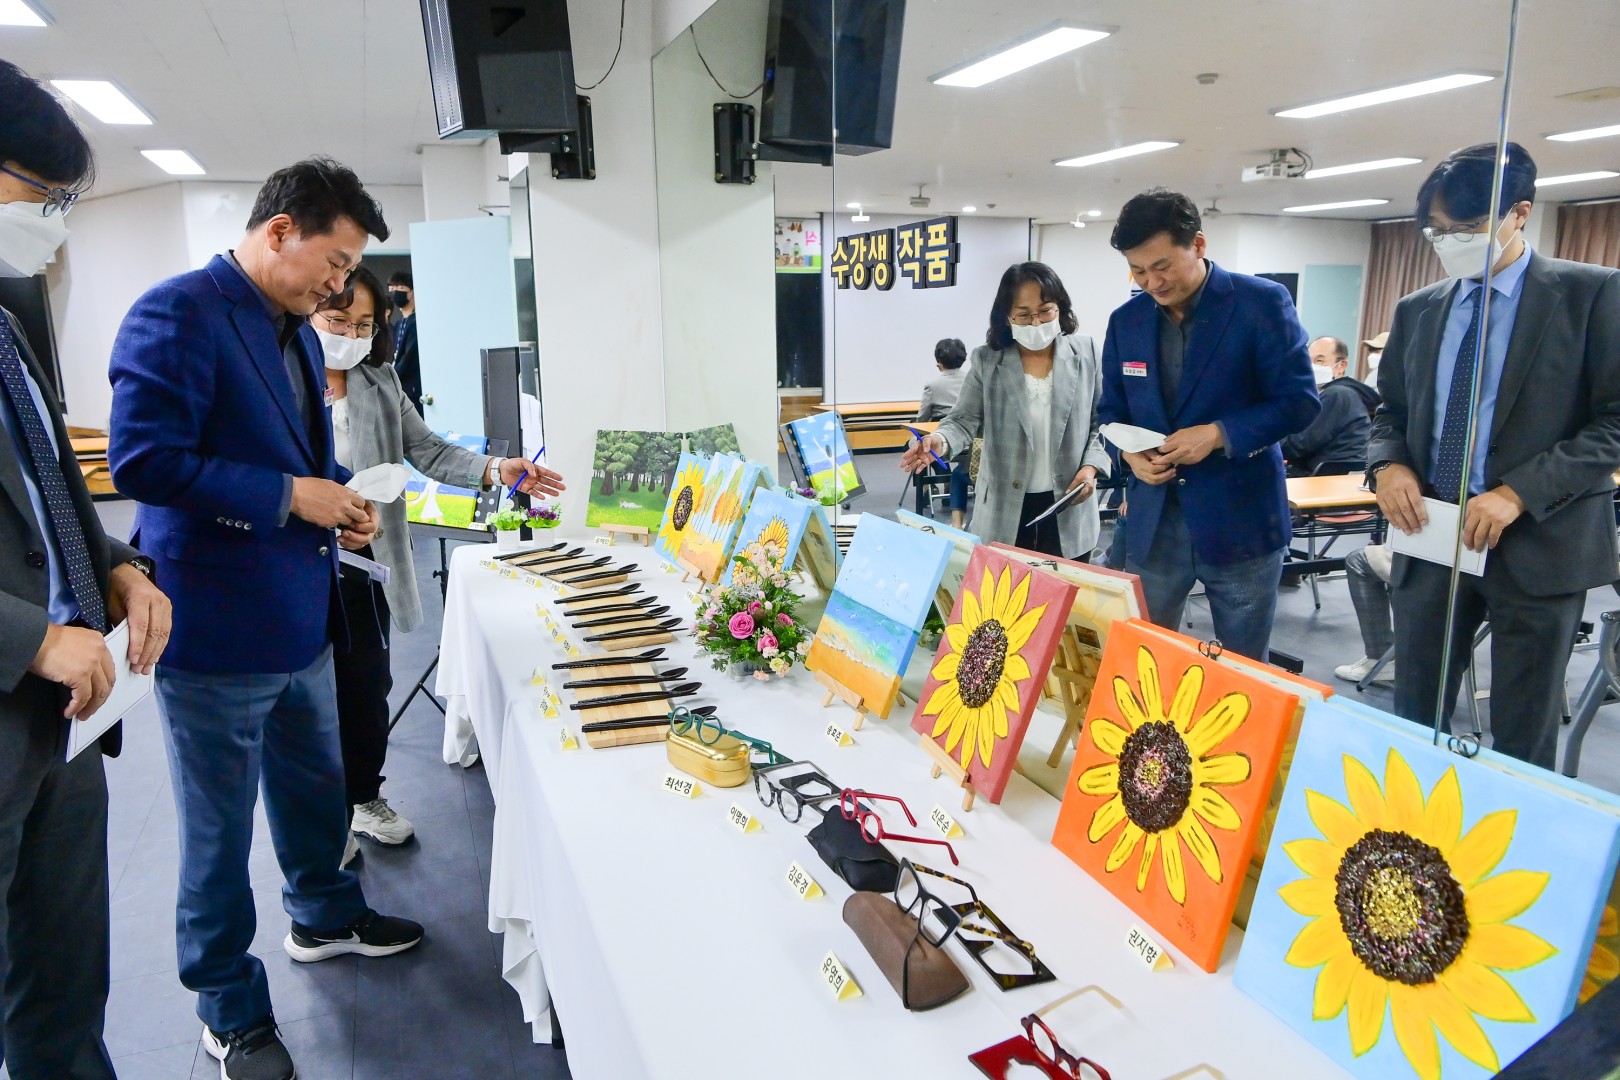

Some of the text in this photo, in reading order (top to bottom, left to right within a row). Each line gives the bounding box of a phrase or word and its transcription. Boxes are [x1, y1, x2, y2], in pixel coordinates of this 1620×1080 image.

[831, 219, 955, 288] 수강생 작품
[826, 724, 843, 744] 송효준
[664, 776, 693, 796] 최선경
[730, 805, 749, 830] 이명희
[931, 809, 951, 834] 신은순
[787, 865, 809, 894] 김윤경
[1128, 929, 1158, 965] 권지향
[821, 956, 845, 994] 유영희
